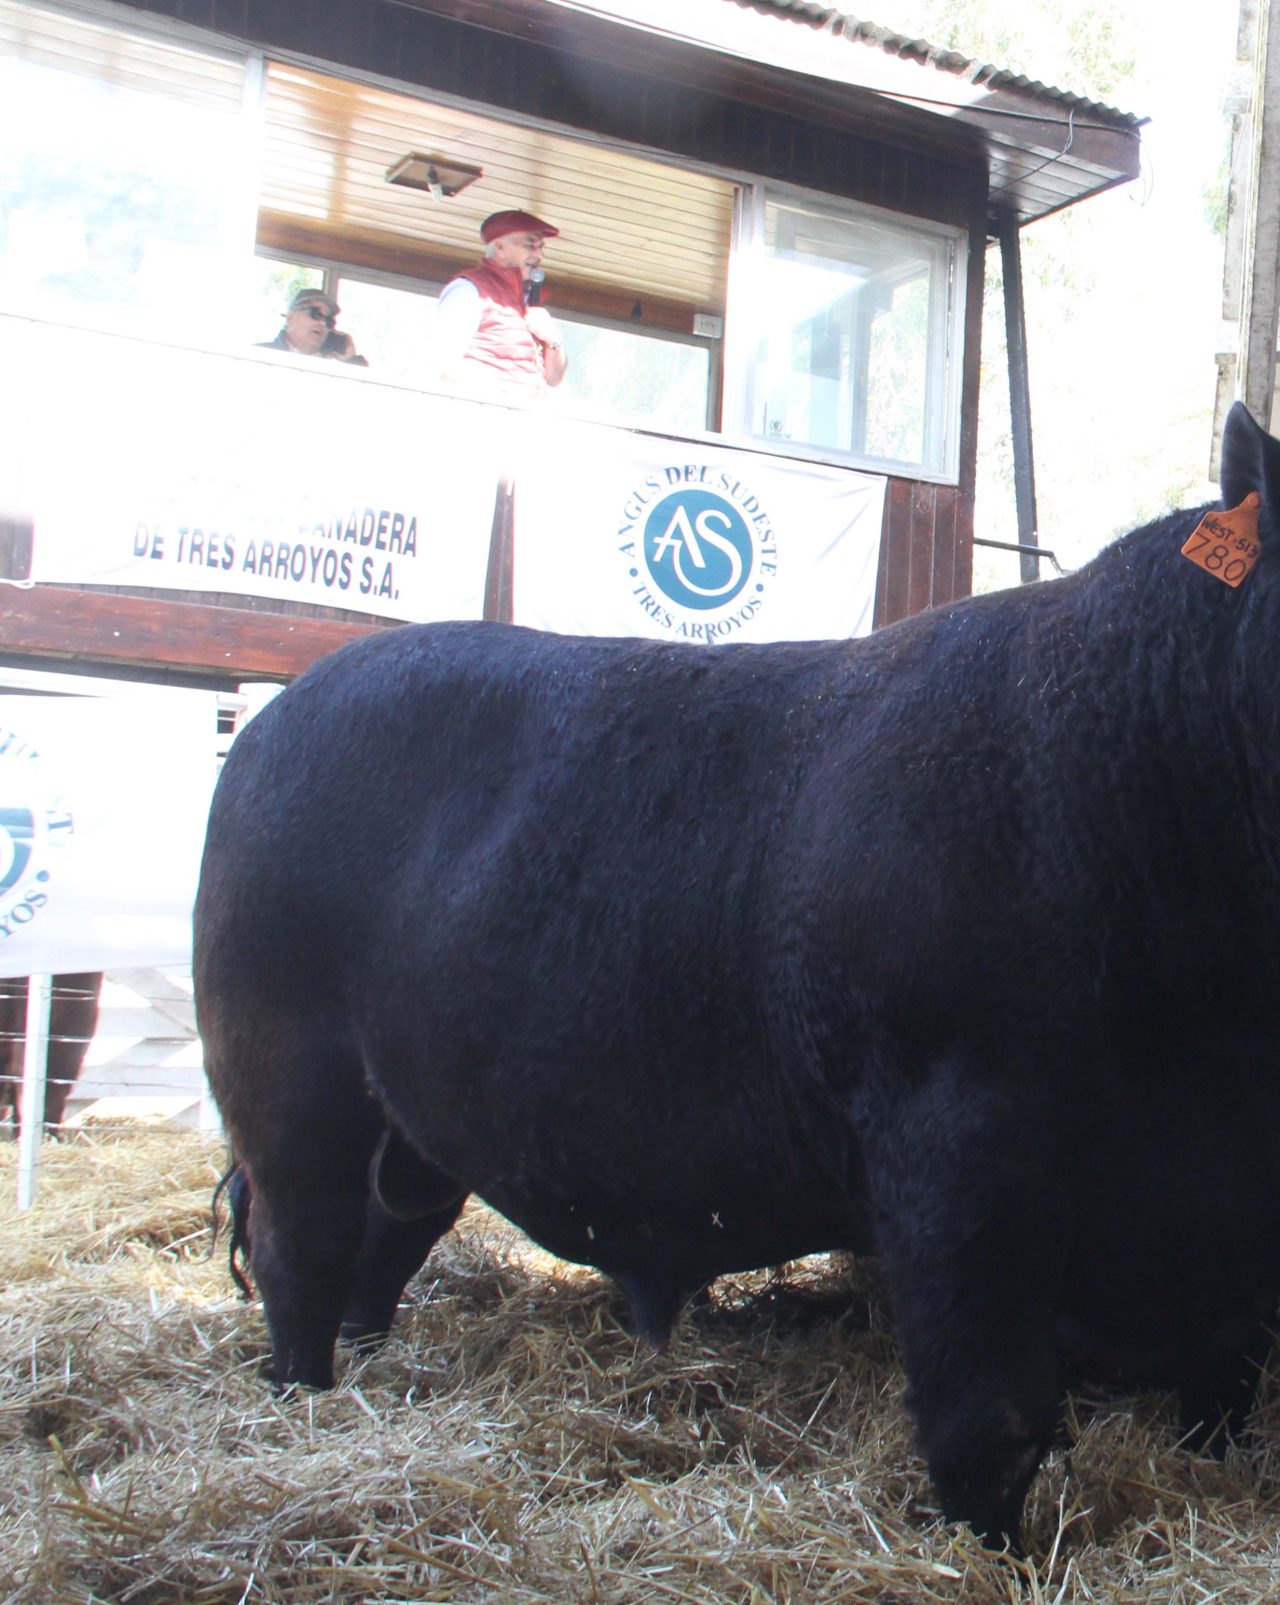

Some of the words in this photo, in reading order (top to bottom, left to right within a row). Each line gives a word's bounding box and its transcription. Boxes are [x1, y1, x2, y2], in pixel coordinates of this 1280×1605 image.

[618, 475, 662, 558] ANGUS
[664, 464, 713, 486] DEL
[717, 472, 778, 577] SUDESTE
[133, 522, 164, 560] DE
[177, 527, 236, 570] TRES
[242, 538, 353, 590] ARROYOS
[359, 556, 400, 600] S.A.
[1186, 532, 1247, 581] 780
[633, 581, 675, 629] TRES
[675, 595, 763, 640] ARROYOS
